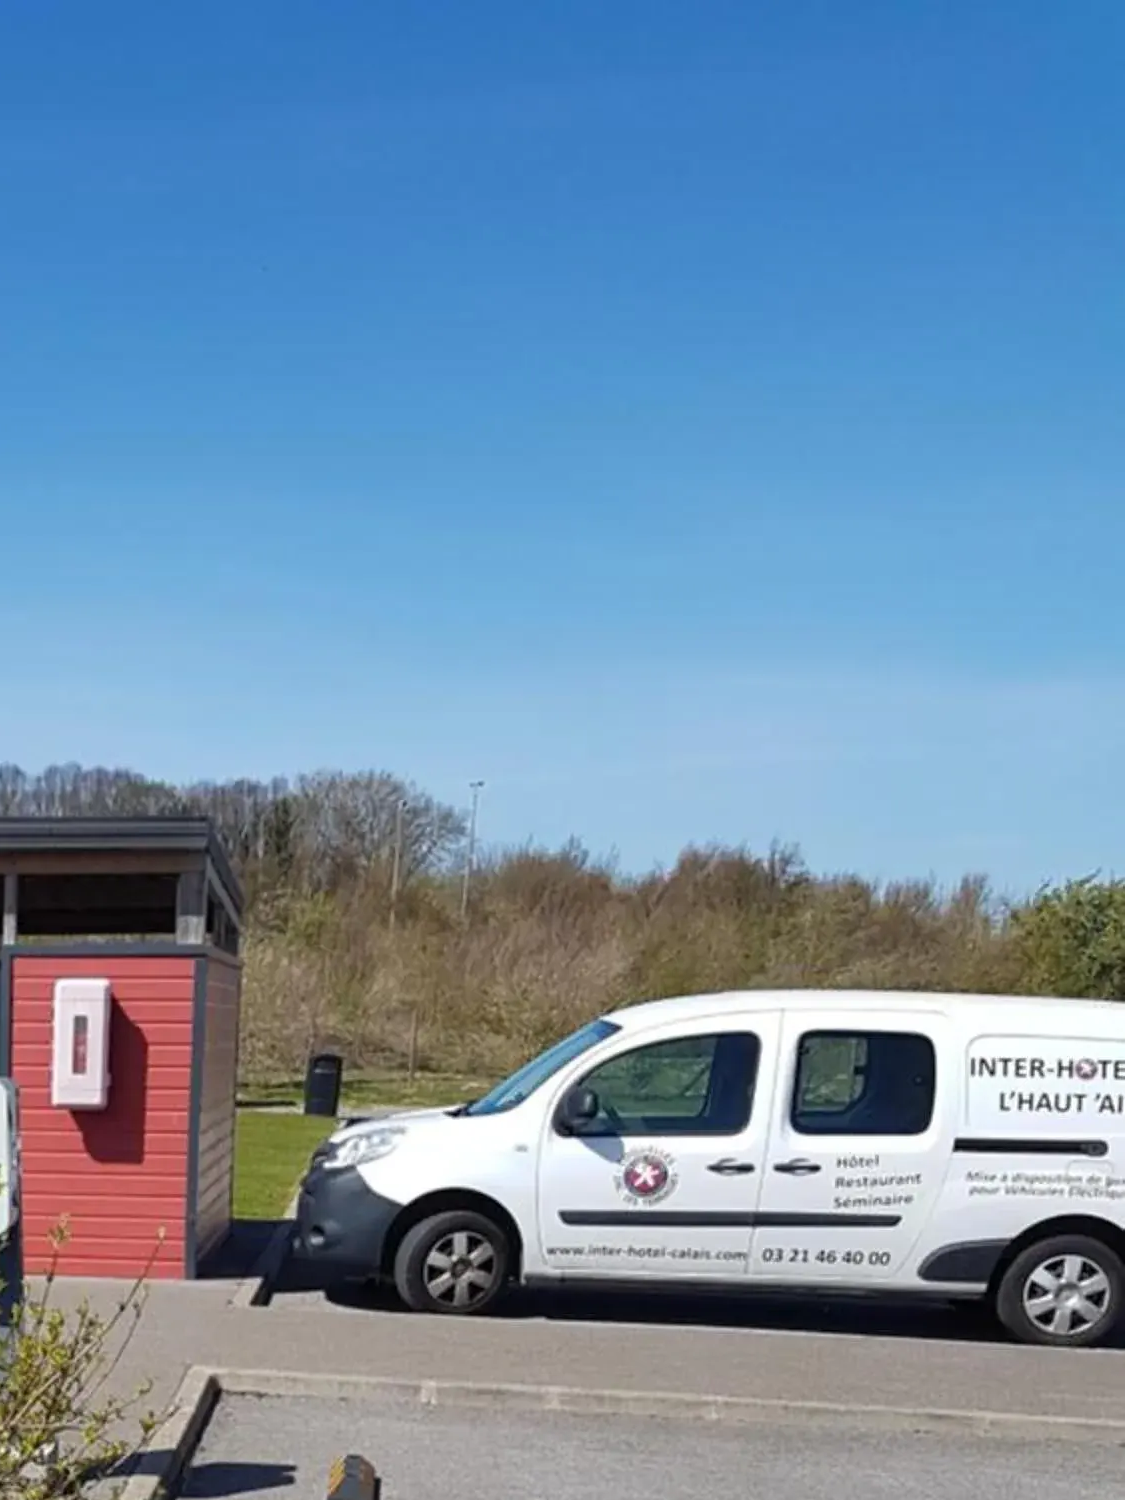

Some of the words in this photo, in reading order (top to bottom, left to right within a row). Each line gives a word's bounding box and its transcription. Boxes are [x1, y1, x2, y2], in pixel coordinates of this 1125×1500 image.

[836, 1154, 880, 1169] Hôtel
[834, 1173, 923, 1189] Restaurant
[833, 1194, 915, 1210] Séminaire
[546, 1243, 748, 1262] www.inter-hotel-calais.com
[762, 1247, 784, 1264] 03
[789, 1248, 810, 1264] 21
[815, 1249, 837, 1265] 46
[842, 1250, 864, 1266] 40
[868, 1251, 892, 1267] 00
